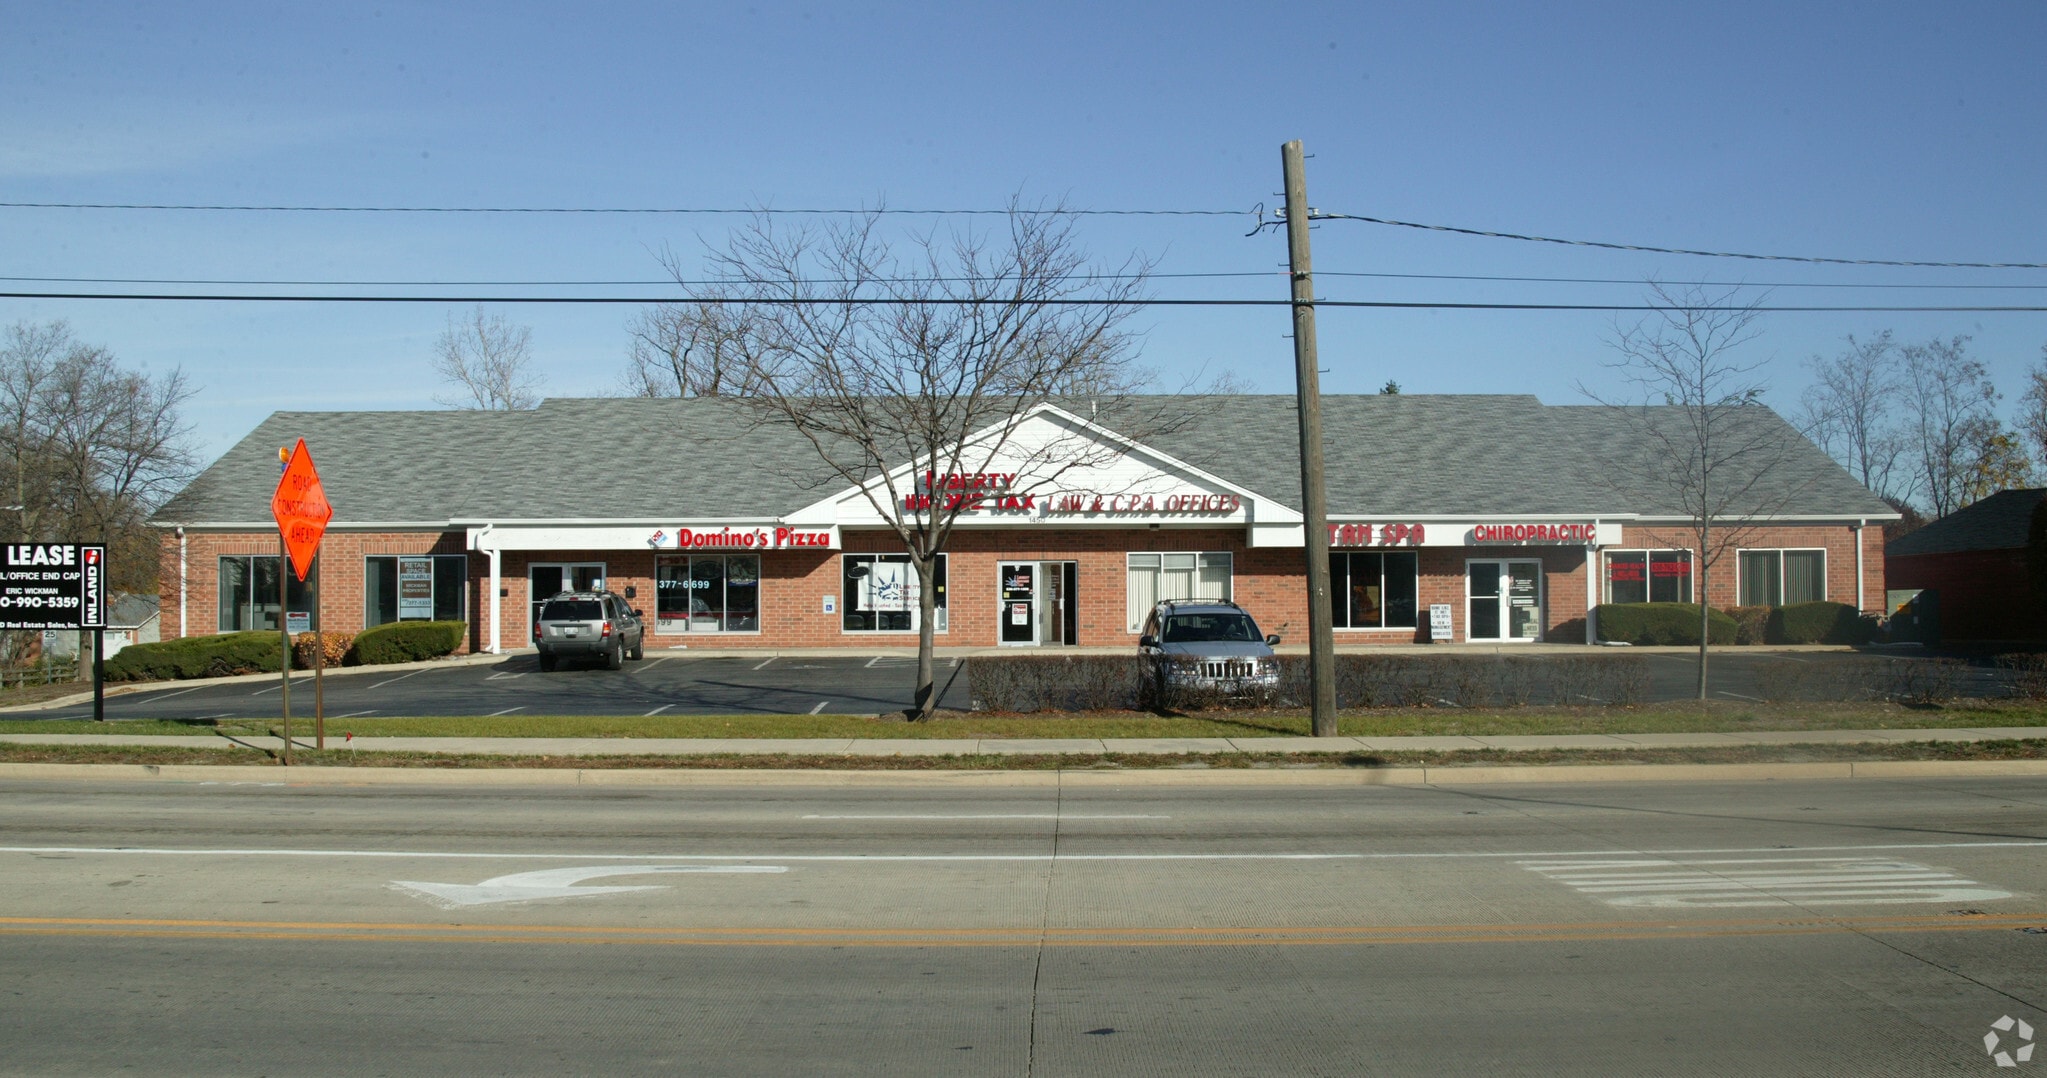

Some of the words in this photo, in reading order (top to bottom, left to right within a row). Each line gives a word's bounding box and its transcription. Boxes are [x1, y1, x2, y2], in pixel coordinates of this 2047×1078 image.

[292, 474, 312, 491] ROAD
[926, 470, 1016, 490] LIBERTY
[277, 498, 326, 518] CONSTRUCTION
[997, 493, 1035, 510] TAX
[1047, 494, 1087, 512] LAW
[1091, 494, 1104, 512] &
[1113, 494, 1158, 512] C.P.A.
[1166, 494, 1240, 512] OFFICES
[291, 527, 315, 544] AHEAD
[679, 526, 768, 546] Domino's
[775, 527, 830, 546] Pizza
[1327, 523, 1372, 544] TAN
[1383, 523, 1425, 544] SPA
[1474, 523, 1596, 541] CHIROPRACTIC
[8, 545, 75, 566] LEASE
[42, 572, 60, 580] END
[62, 572, 81, 580] CAP
[658, 580, 710, 589] 377-6699
[5, 587, 23, 595] ERIC
[24, 587, 59, 595] WICKMAN
[87, 566, 98, 624] INLAND
[7, 621, 21, 629] Real
[23, 621, 46, 629] Estate
[47, 621, 67, 630] Sales,
[68, 621, 80, 629] Inc.
